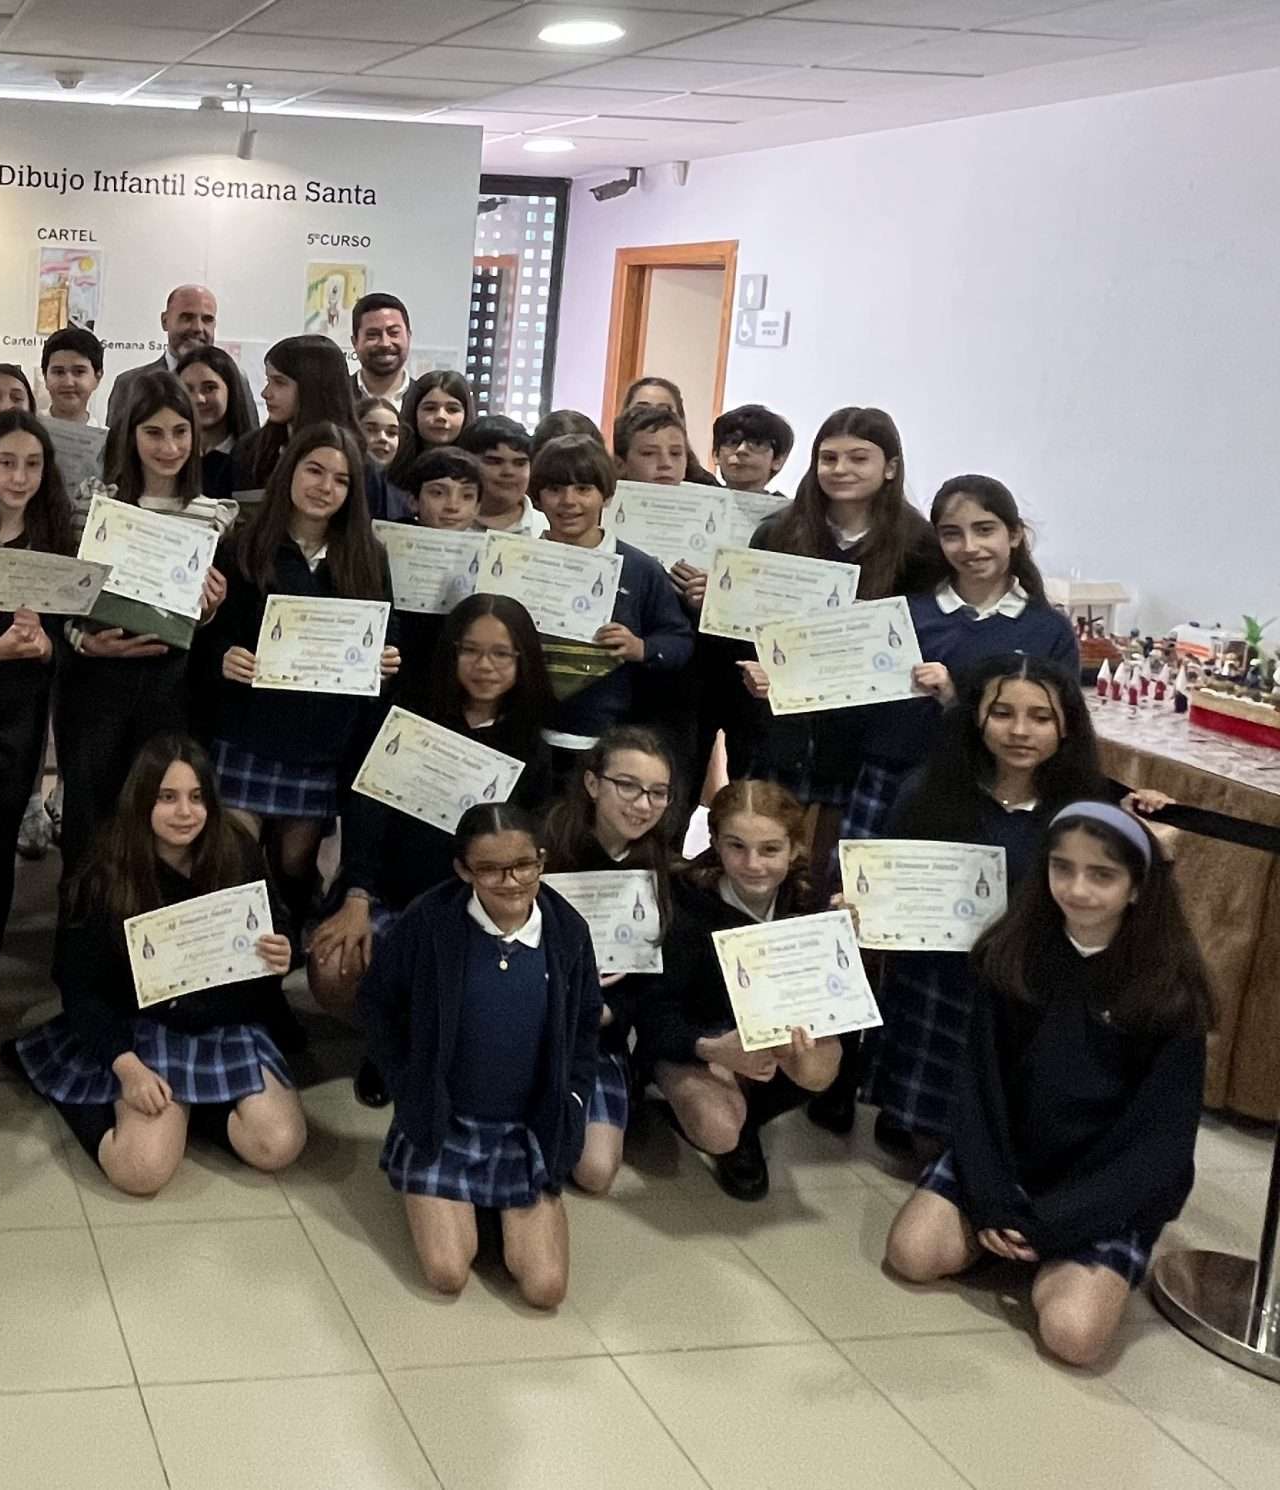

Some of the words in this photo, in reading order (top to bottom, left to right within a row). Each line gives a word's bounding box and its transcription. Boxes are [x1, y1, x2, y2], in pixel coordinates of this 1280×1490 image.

[93, 170, 186, 196] Infantil
[194, 175, 297, 201] Semana
[305, 181, 377, 205] Santa
[37, 227, 97, 242] CARTEL
[3, 335, 36, 346] Cartel
[100, 339, 145, 350] Semana
[148, 340, 169, 351] San
